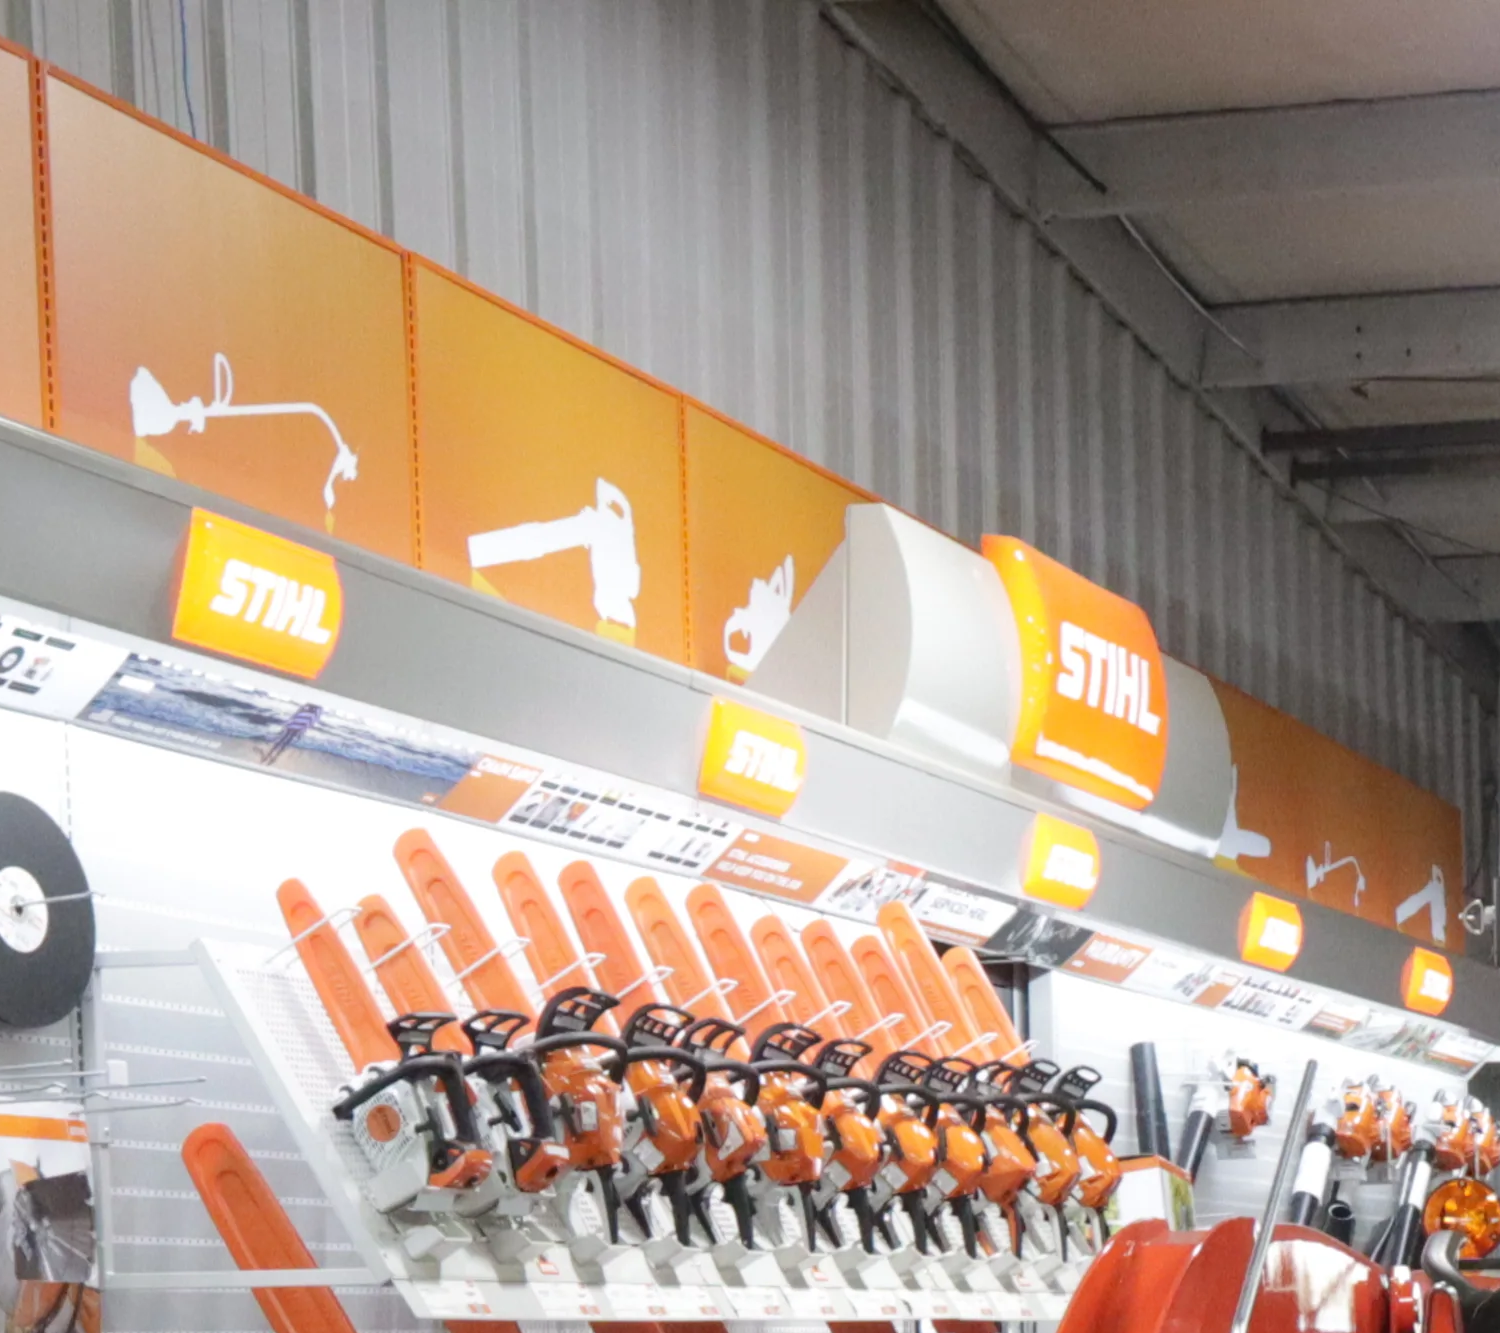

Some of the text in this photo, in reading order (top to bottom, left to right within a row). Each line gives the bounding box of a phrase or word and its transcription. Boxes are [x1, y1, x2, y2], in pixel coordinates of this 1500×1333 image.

[209, 557, 332, 646] STIHL
[1055, 620, 1162, 737] STIHL
[723, 729, 804, 793] STIHL
